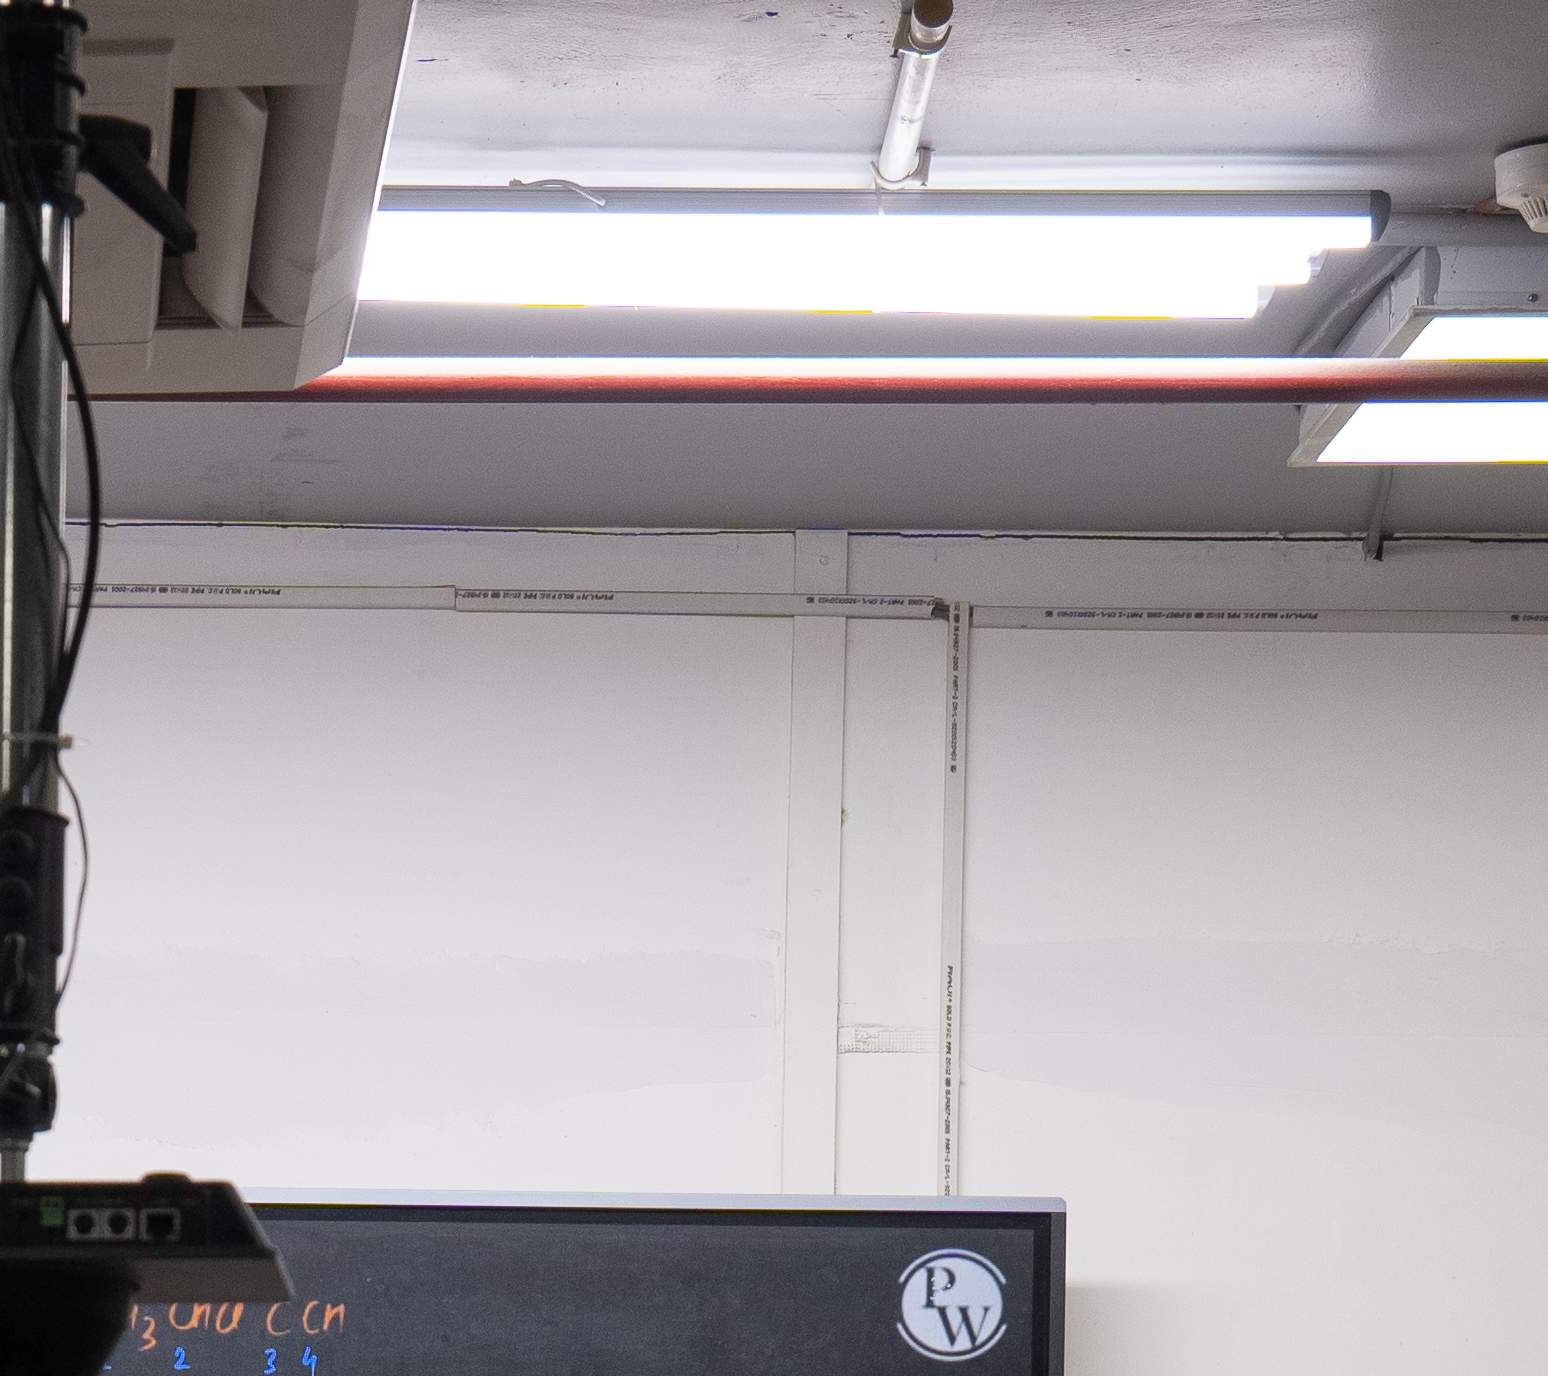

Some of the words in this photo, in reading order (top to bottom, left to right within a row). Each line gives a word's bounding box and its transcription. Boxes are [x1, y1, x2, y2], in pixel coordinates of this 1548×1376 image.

[173, 1345, 191, 1370] 2
[263, 1348, 278, 1376] 3
[301, 1346, 318, 1376] 4
